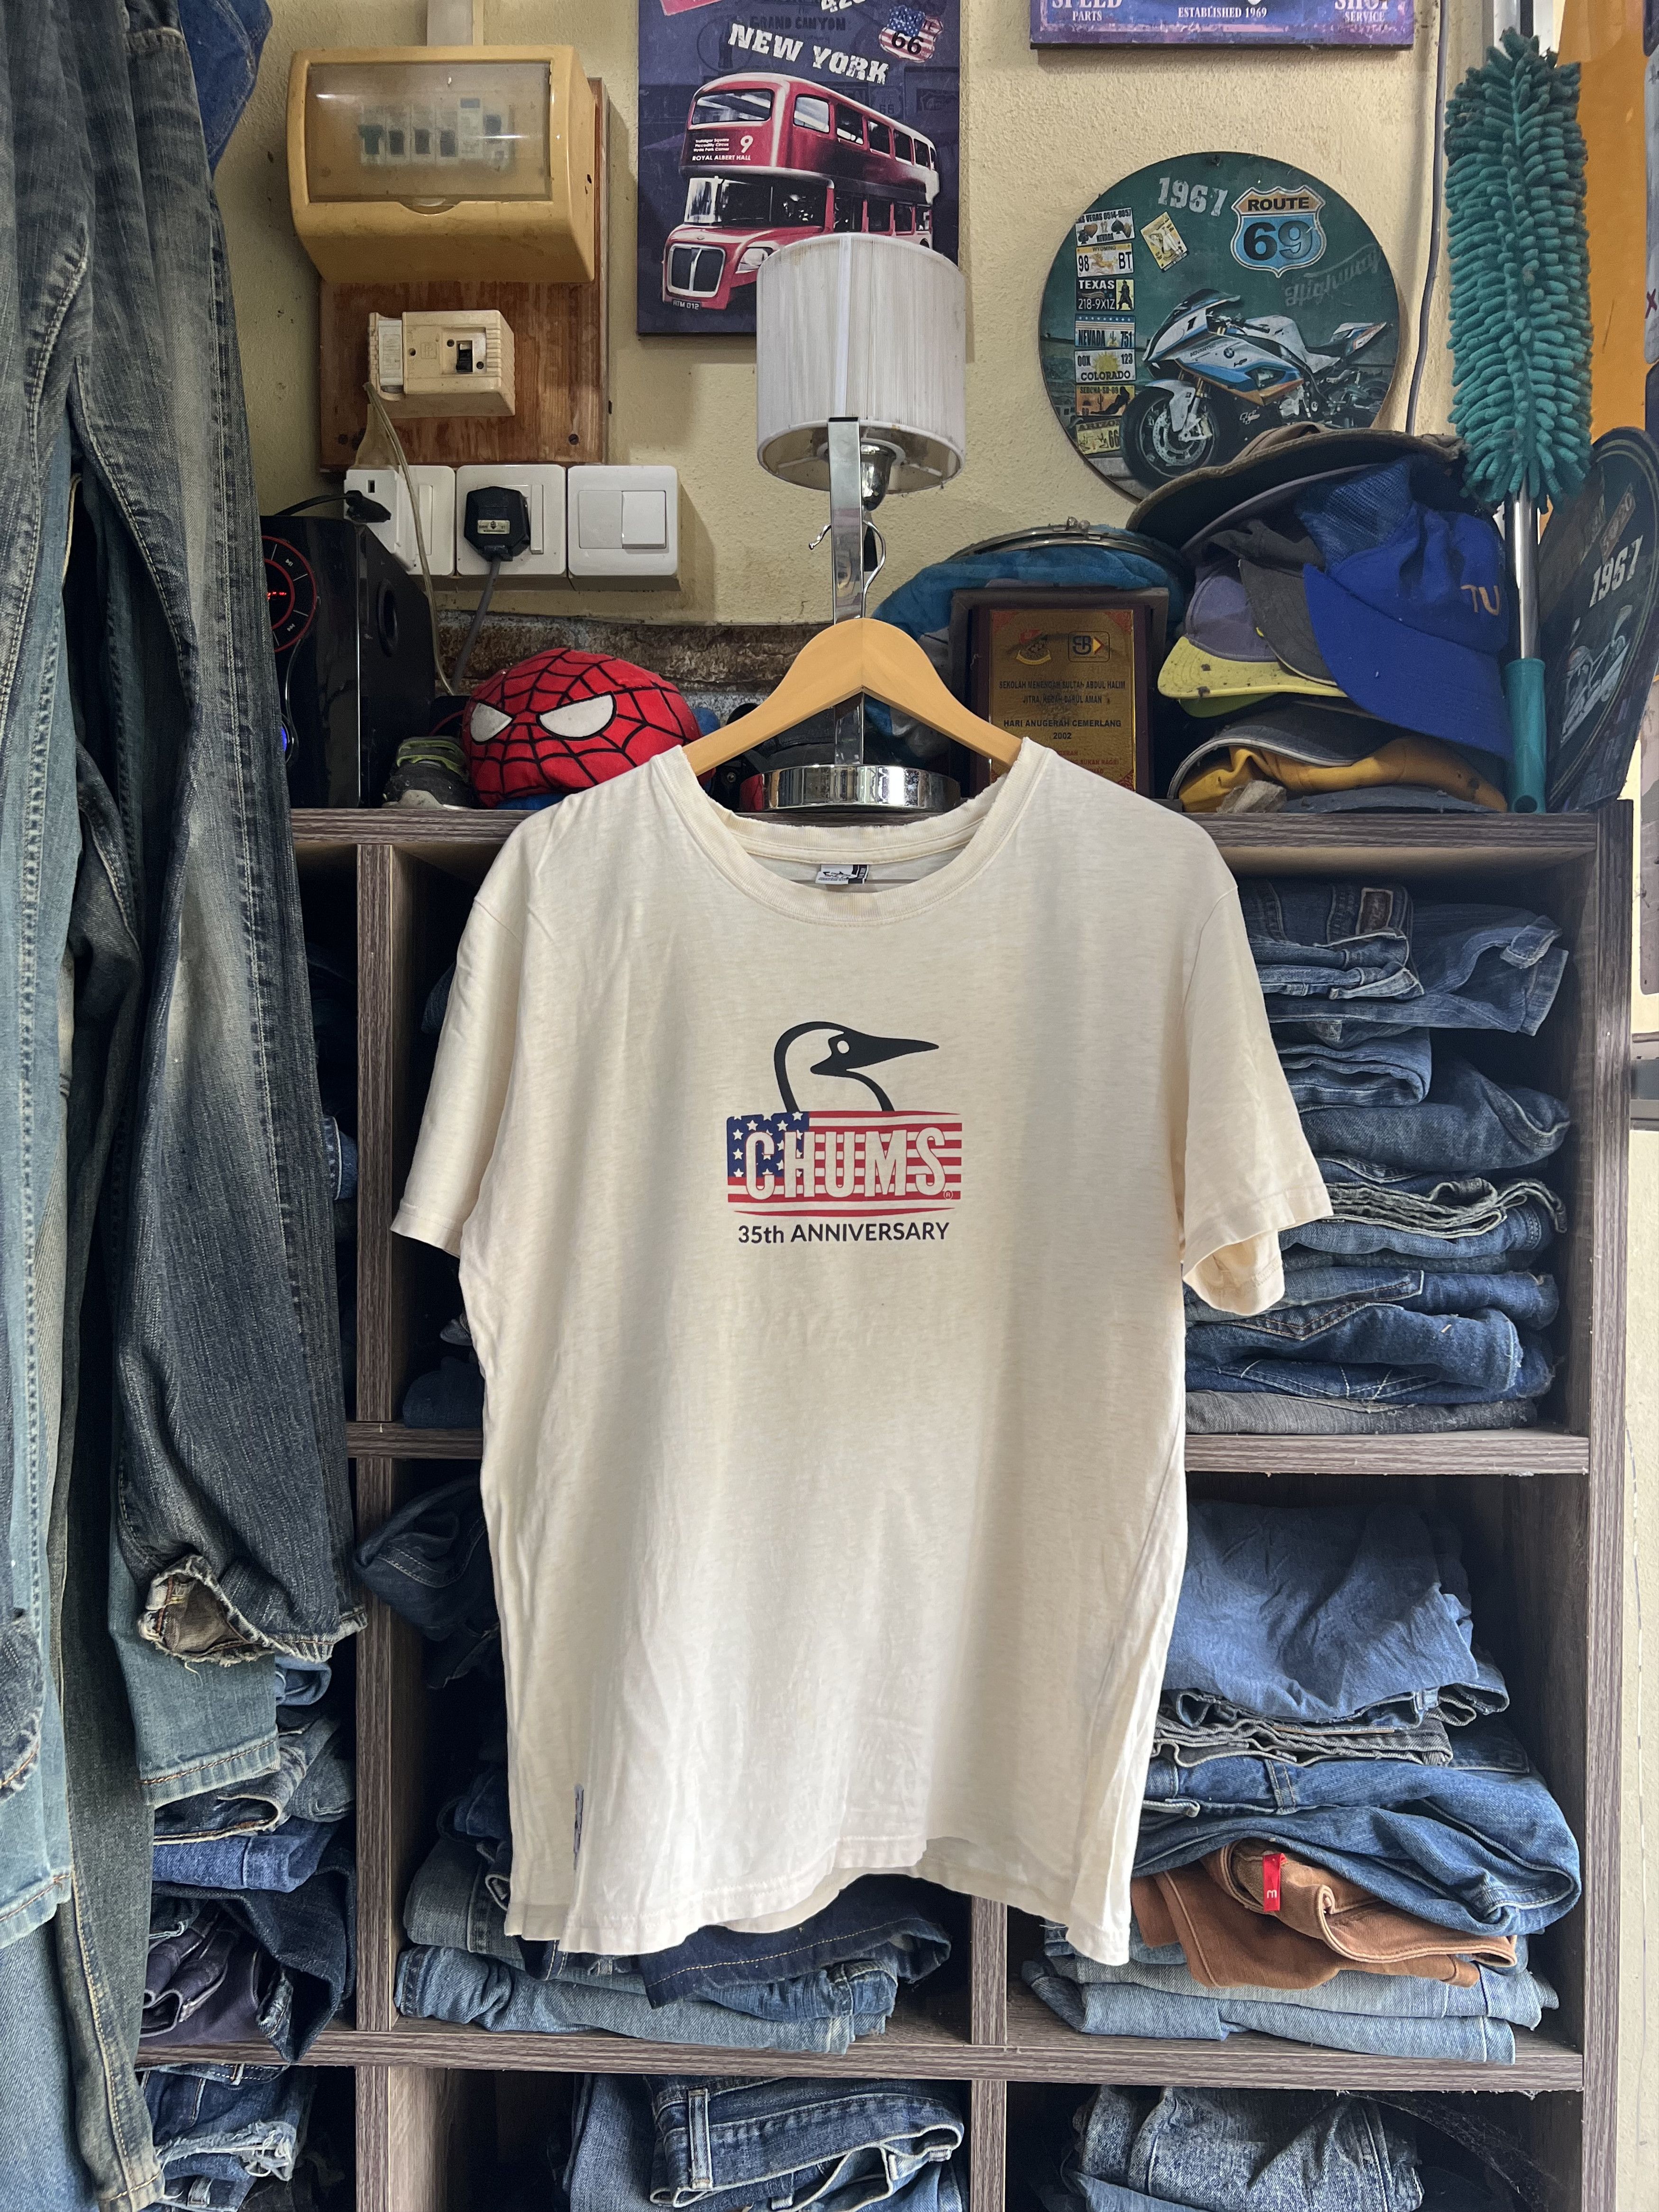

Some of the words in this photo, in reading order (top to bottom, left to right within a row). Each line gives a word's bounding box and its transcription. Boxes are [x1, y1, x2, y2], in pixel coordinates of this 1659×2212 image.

[1072, 10, 1102, 21] PARTS
[1178, 7, 1242, 18] ESTABLISHED
[1245, 7, 1267, 18] 1969
[1345, 10, 1385, 22] SERVICE
[892, 30, 924, 55] 66
[728, 23, 804, 62] NEW
[812, 46, 889, 84] YORK
[740, 135, 754, 154] 9
[1158, 177, 1228, 217] 1967
[1248, 197, 1310, 211] ROUTE
[1243, 220, 1313, 261] 69
[1078, 255, 1089, 272] 98
[1118, 251, 1131, 269] BT
[1078, 280, 1115, 289] TEXAS
[1078, 298, 1115, 309] 218-9X1Z
[1187, 316, 1197, 331] 1
[1078, 329, 1106, 346] NEVADA
[1121, 331, 1132, 348] 751
[1121, 353, 1133, 365] 123
[1081, 370, 1130, 381] COLORADO
[1589, 535, 1643, 608] 1967
[999, 681, 1026, 689] SEKOLAH
[1085, 681, 1106, 689] ABDUL
[1107, 681, 1126, 689] HALIM
[1085, 695, 1102, 703] AMAN
[746, 1127, 946, 1200] CHUMS
[738, 1224, 784, 1244] 35th
[791, 1221, 950, 1243] ANNIVERSARY
